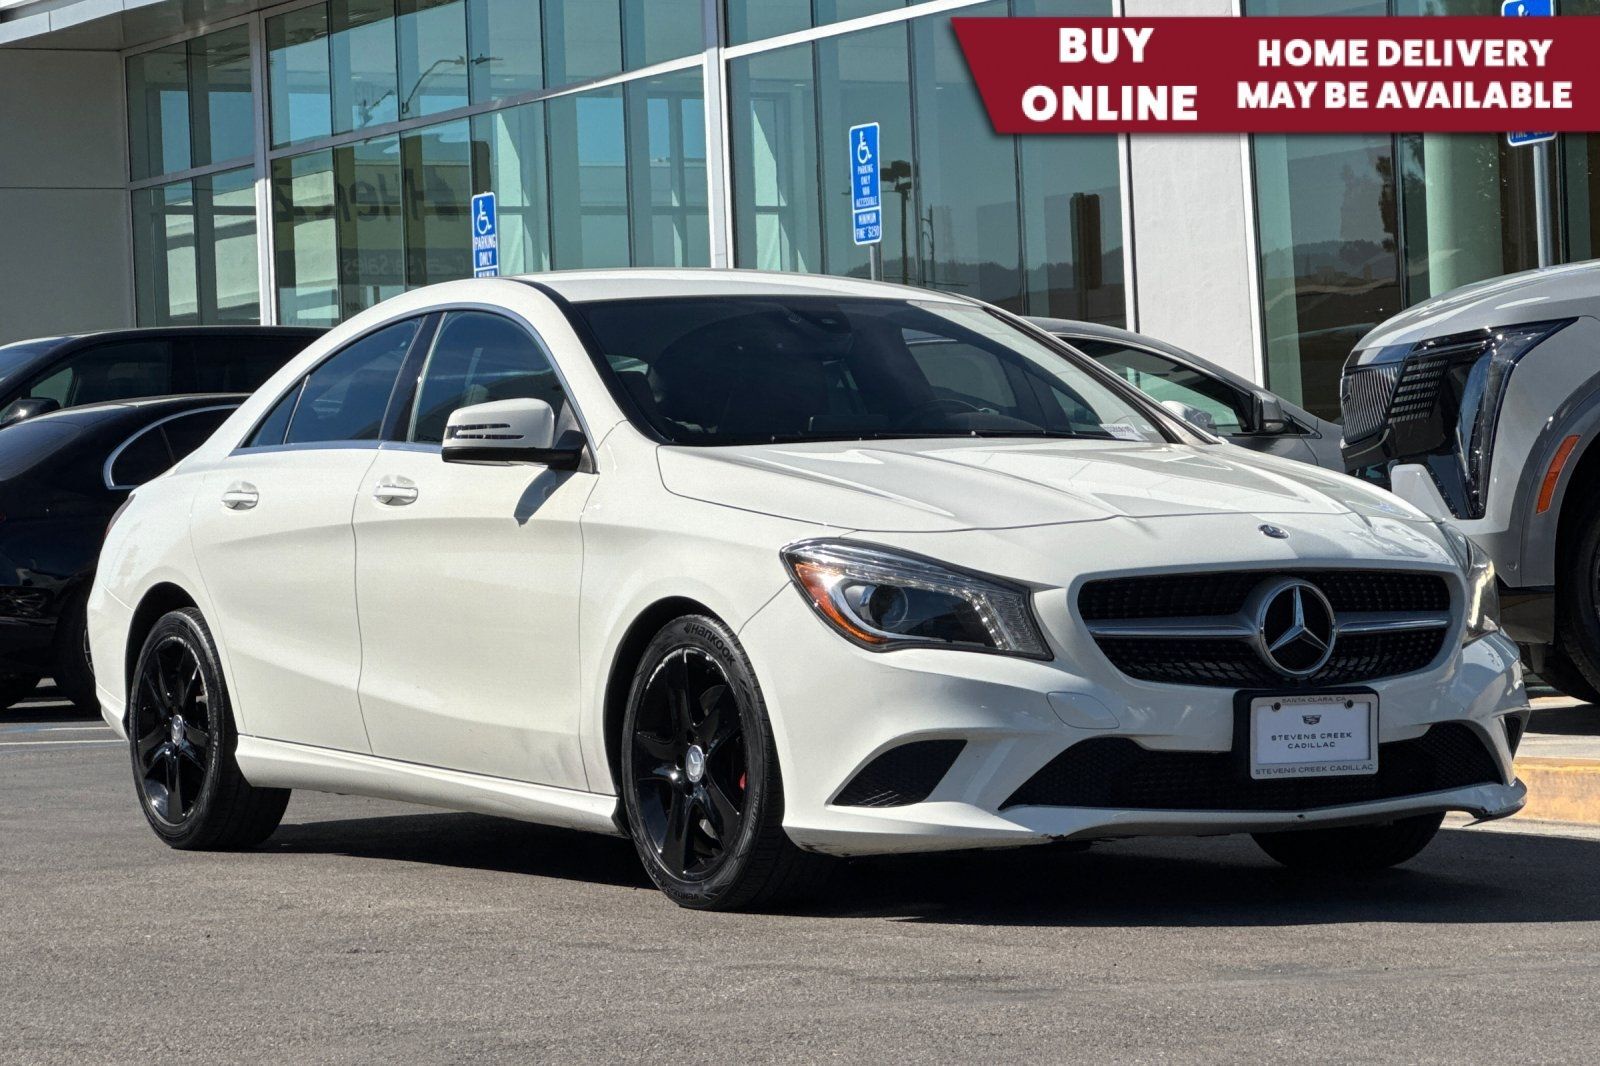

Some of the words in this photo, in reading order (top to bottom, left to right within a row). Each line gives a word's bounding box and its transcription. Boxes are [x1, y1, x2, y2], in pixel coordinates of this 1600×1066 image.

[858, 164, 874, 174] PARKING
[860, 174, 870, 186] ONLY
[856, 228, 866, 240] FINE
[474, 234, 496, 250] PARKING
[479, 250, 492, 266] ONLY
[1271, 733, 1317, 742] STEVENS
[1320, 731, 1353, 740] CREEK
[1287, 741, 1337, 750] CADILLAC
[1255, 765, 1297, 775] STEVENS
[1298, 765, 1328, 774] CREEK
[1330, 763, 1375, 773] CADILLAC
